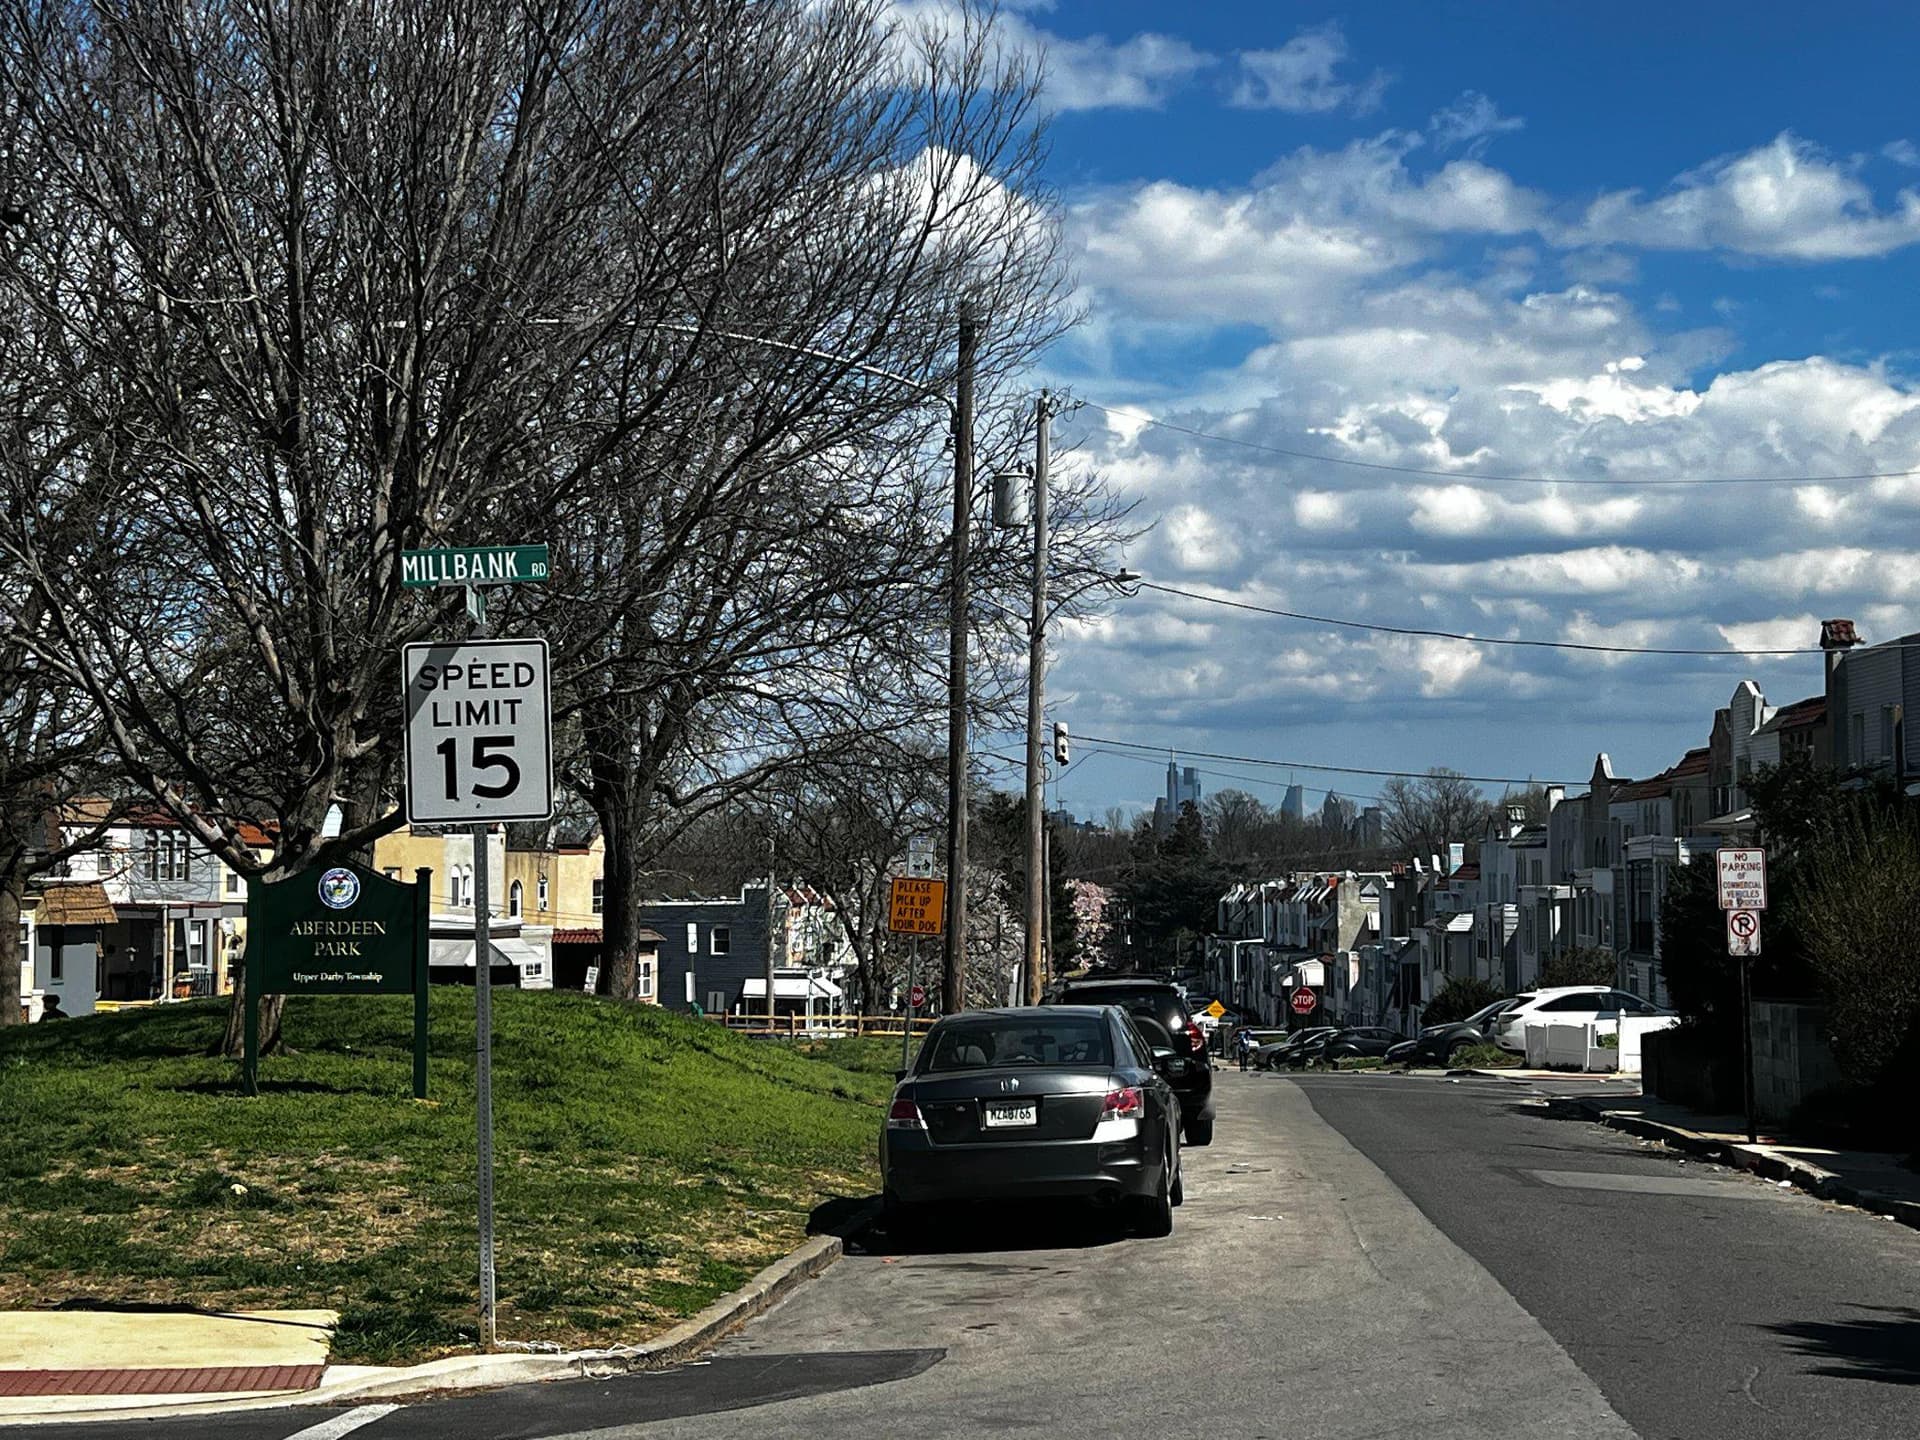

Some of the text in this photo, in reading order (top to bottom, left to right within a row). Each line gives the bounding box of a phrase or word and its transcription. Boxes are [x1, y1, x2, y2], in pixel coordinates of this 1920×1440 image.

[402, 551, 547, 581] MILLBANK RD
[418, 662, 535, 691] SPEED
[432, 699, 523, 727] LIMIT
[436, 735, 521, 801] 15
[1734, 853, 1748, 861] NO
[1722, 862, 1761, 871] PARKING
[898, 881, 931, 893] PLEASE
[896, 895, 932, 906] PICK UP
[897, 907, 925, 918] AFTER
[289, 920, 386, 936] ABERDEEN
[893, 919, 937, 932] YOUR DOG
[313, 941, 362, 956] PARK
[293, 971, 383, 984] Upper Darby Township
[1293, 995, 1314, 1005] STOP
